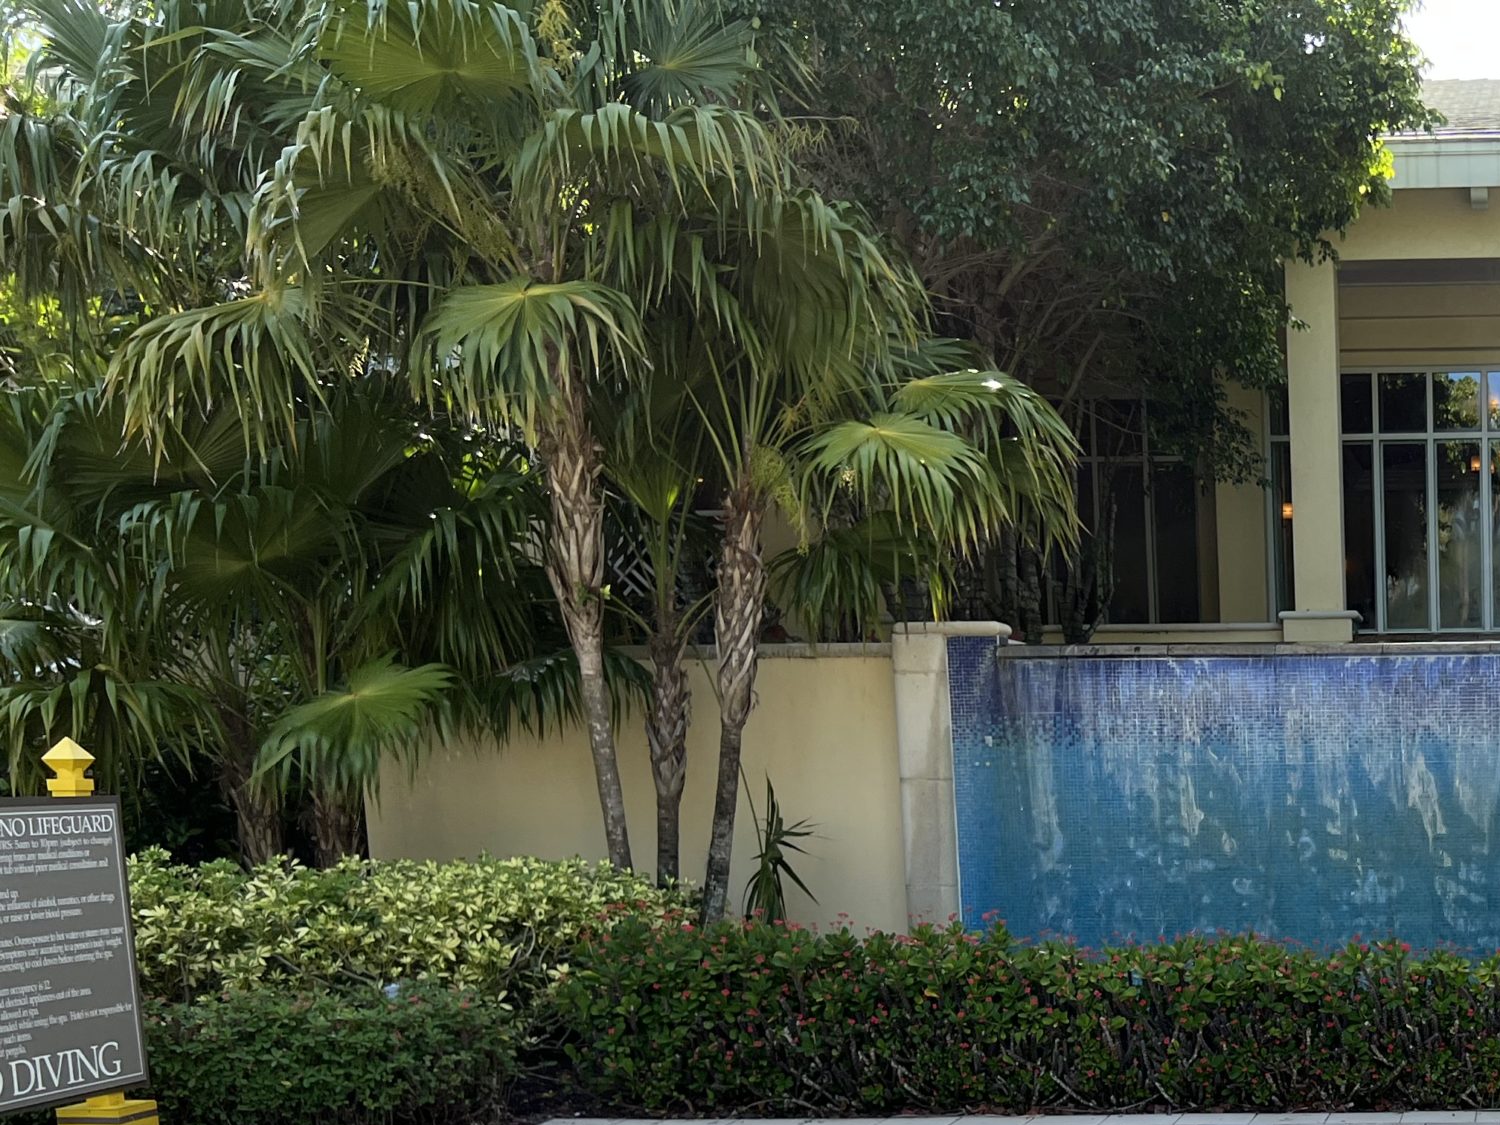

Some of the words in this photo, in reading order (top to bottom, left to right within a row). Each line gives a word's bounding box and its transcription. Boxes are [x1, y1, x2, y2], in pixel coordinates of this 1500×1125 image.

[0, 818, 26, 837] NO
[28, 814, 113, 836] LIFEGUARD
[8, 1041, 121, 1096] DIVING
